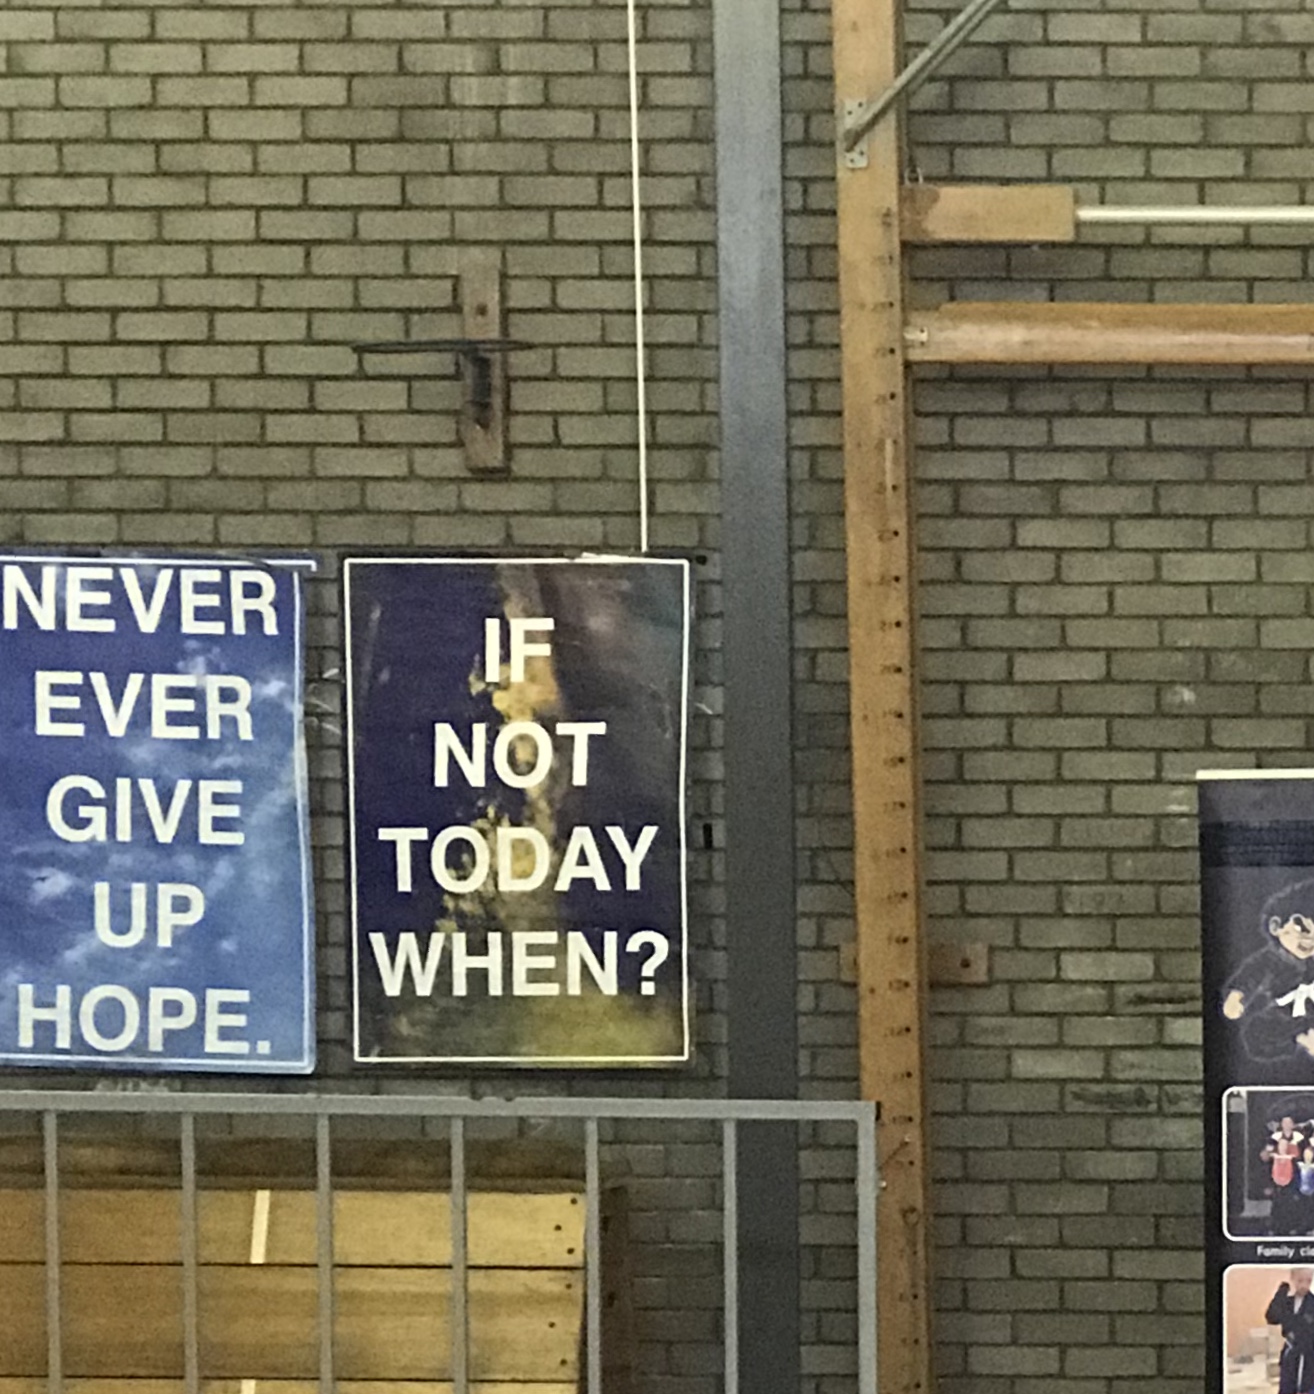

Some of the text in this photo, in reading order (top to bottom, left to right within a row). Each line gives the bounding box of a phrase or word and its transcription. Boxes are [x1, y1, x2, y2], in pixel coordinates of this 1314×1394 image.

[4, 566, 279, 635] NEVER
[484, 617, 556, 683] IF
[35, 671, 253, 740] EVER
[433, 721, 607, 788] NOT
[46, 775, 245, 845] GIVE
[378, 825, 659, 893] TODAY
[94, 882, 205, 948] UP
[369, 931, 669, 996] WHEN?
[17, 984, 271, 1054] HOPE.
[1257, 1245, 1294, 1258] Family
